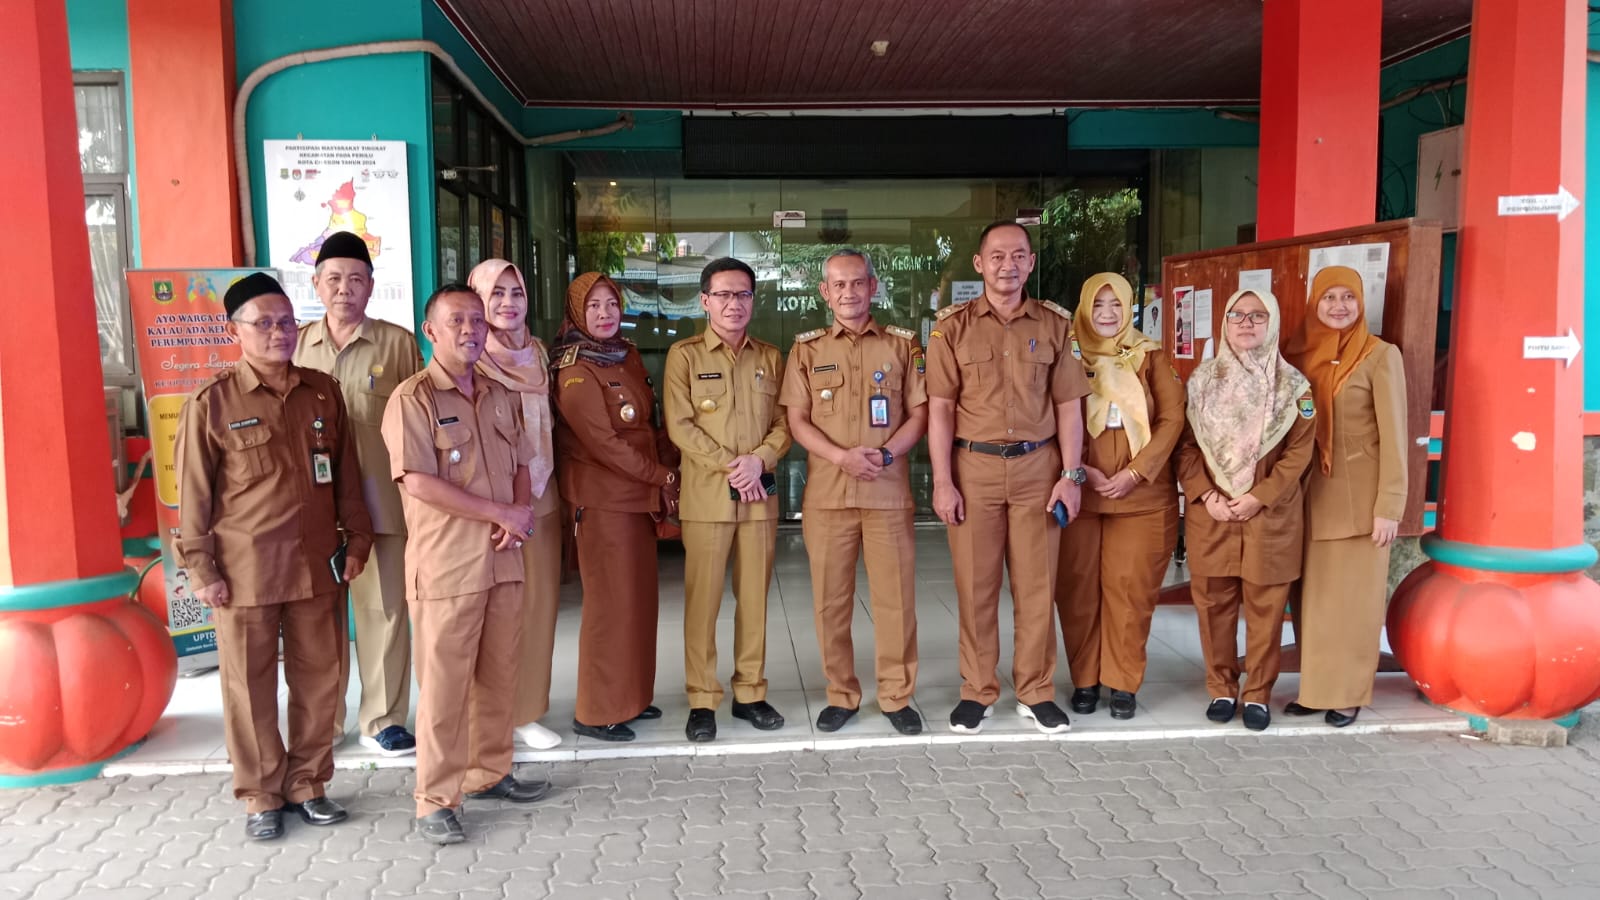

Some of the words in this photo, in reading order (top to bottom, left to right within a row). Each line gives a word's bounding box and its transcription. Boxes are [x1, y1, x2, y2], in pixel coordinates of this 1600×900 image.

[776, 296, 818, 312] KOTA
[156, 314, 176, 324] AYO
[178, 314, 213, 323] WARGA
[147, 327, 183, 336] KALAU
[185, 326, 208, 335] ADA
[151, 338, 213, 347] PEREMPUAN
[213, 337, 234, 345] DAN
[160, 354, 200, 371] Segera
[192, 631, 216, 642] UPTD
